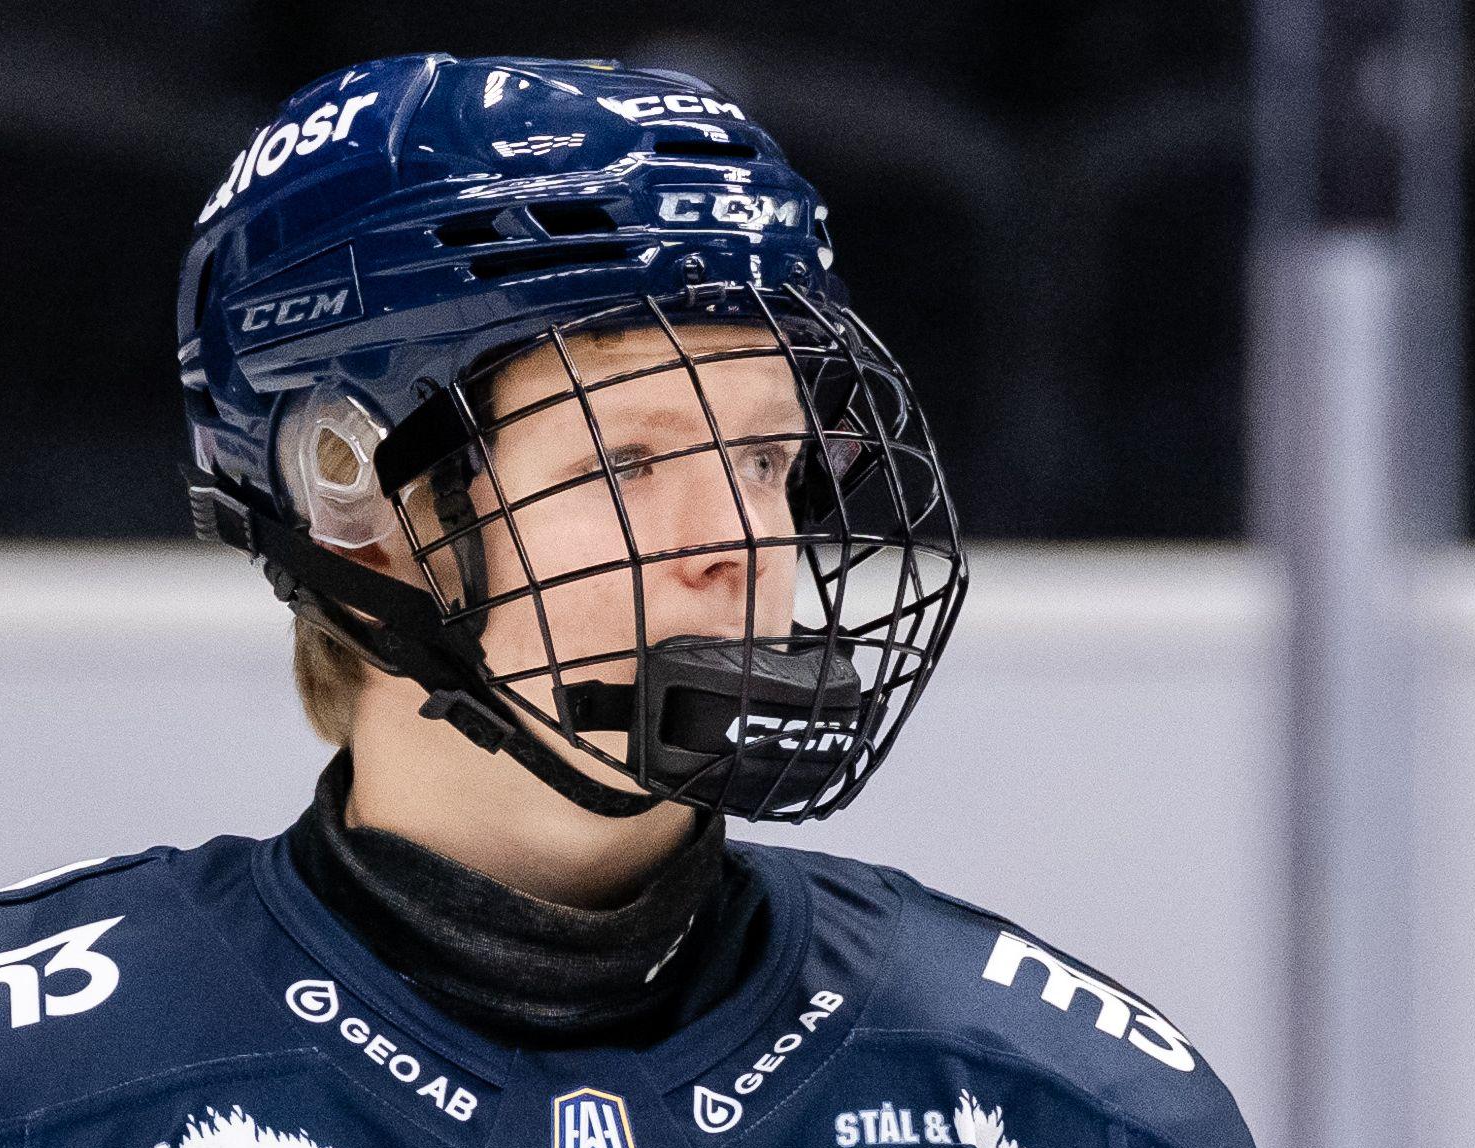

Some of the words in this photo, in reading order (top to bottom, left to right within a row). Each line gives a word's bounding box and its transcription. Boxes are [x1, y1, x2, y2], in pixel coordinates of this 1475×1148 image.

[620, 95, 746, 121] CCM
[658, 192, 800, 227] CCM
[241, 289, 349, 332] CCM
[734, 1033, 803, 1095] GEO
[799, 990, 844, 1032] AB
[340, 1017, 421, 1083] GEO
[418, 1075, 478, 1122] AB
[835, 1101, 920, 1147] STÅL
[924, 1110, 953, 1144] &
